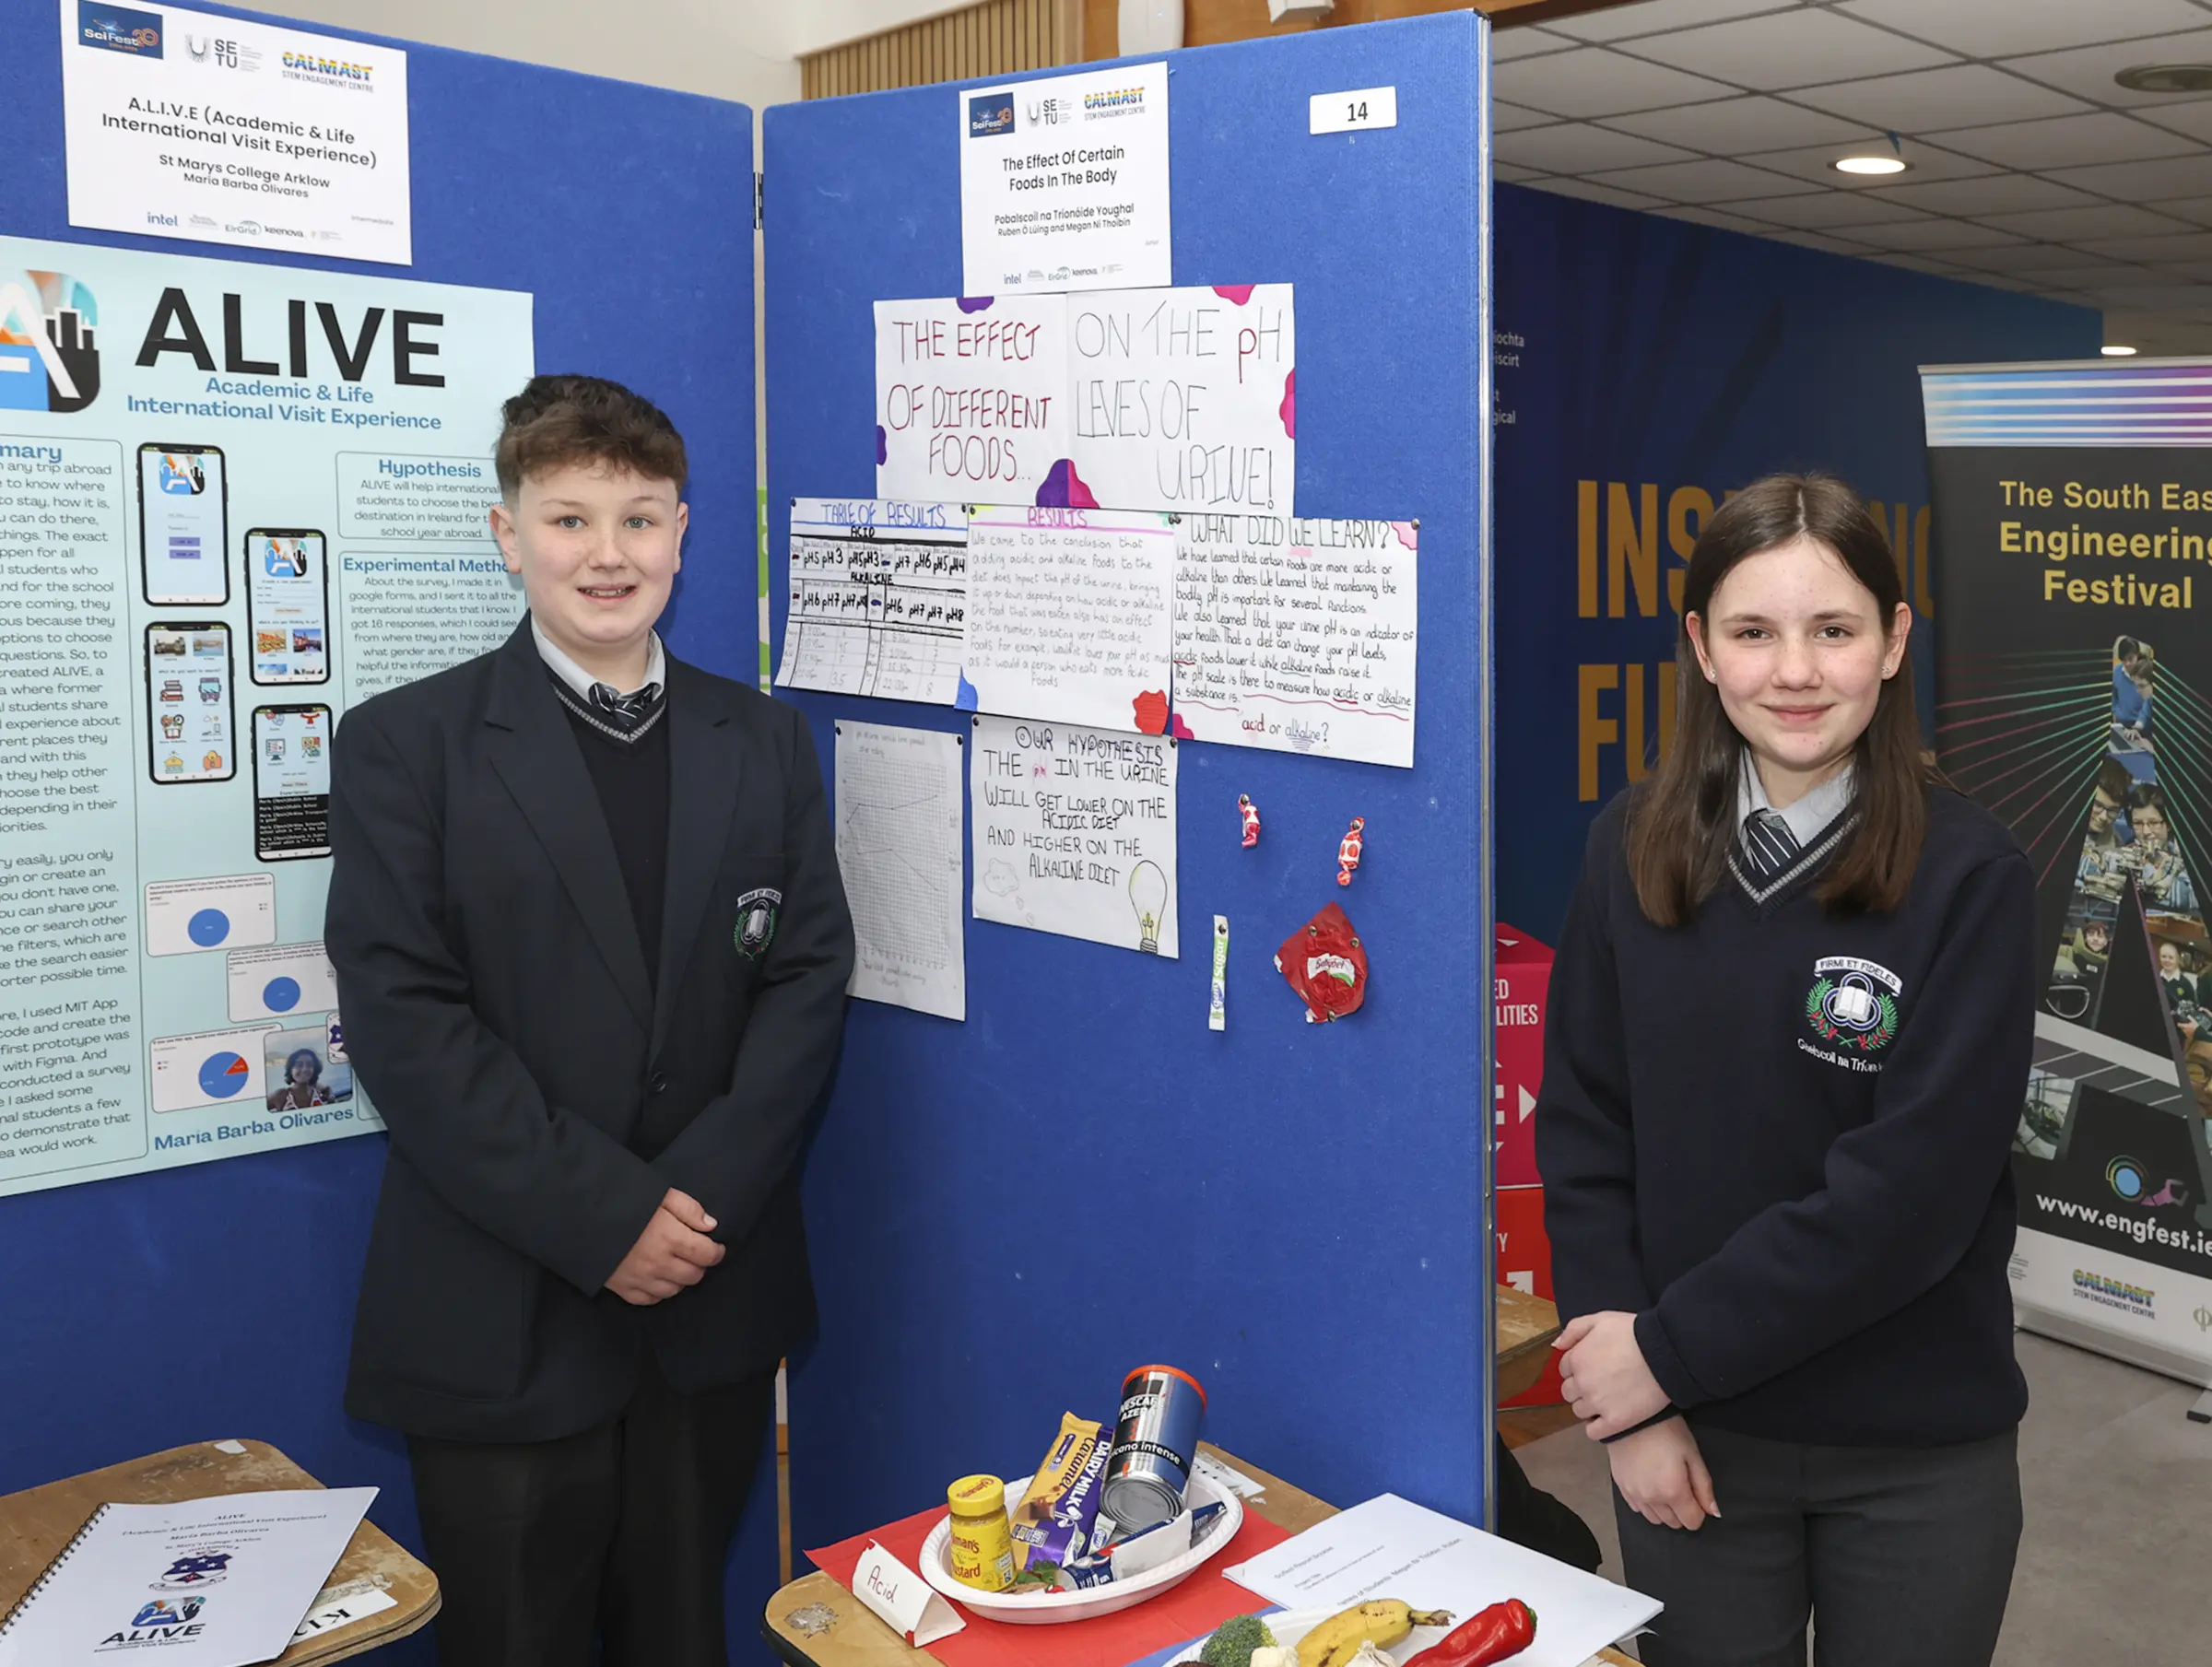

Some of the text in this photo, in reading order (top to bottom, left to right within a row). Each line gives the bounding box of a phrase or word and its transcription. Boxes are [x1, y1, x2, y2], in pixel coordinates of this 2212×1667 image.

[215, 39, 237, 54] SE
[215, 53, 238, 68] TU
[282, 52, 372, 81] CALMAST
[282, 70, 373, 92] STEM ENGAGEMENT CENTRE
[1043, 99, 1057, 112] SE
[1084, 87, 1145, 110] CALMAST
[1347, 101, 1368, 123] 14
[128, 97, 355, 144] A.L.I.V.E (Academic & Life
[1044, 112, 1057, 125] TU
[102, 113, 377, 169] International Visit Experience)
[159, 154, 330, 188] St Marys College Arklow
[1003, 146, 1124, 171] The Effect Of Certain
[184, 173, 309, 198] Maria Barba Olivares
[1009, 168, 1118, 191] Foods In The Body
[147, 212, 178, 227] intel
[265, 226, 304, 239] keenova
[994, 203, 1135, 225] Pobalscoil na Tríonóide Youghal
[998, 228, 1020, 236] Ruben
[1066, 222, 1092, 232] Megan
[1004, 275, 1021, 285] intel
[135, 287, 446, 388] ALIVE
[892, 320, 1041, 364] THE EFFECT
[1076, 300, 1281, 383] ON THE pH
[206, 377, 373, 404] Academic & Life
[127, 395, 441, 429] International Visit Experience
[888, 385, 1051, 430] OF DIFFERENT
[1077, 380, 1206, 440] LEVES OF
[7, 463, 112, 475] any trip abroad
[379, 460, 481, 478] Hypothesis
[1157, 444, 1274, 509] URINE!
[360, 479, 433, 493] ALIVE will help
[1999, 481, 2053, 507] The
[2064, 481, 2149, 509] South
[821, 502, 946, 529] TABLE OF RESULTS
[1028, 507, 1088, 528] RESULTS
[851, 527, 875, 537] ACID
[1191, 514, 1390, 549] WHAT DID WE LEARN?
[344, 558, 455, 573] Experimental
[851, 573, 893, 585] ALKALINE
[2044, 569, 2193, 608] Festival
[1242, 713, 1265, 732] acid
[1269, 724, 1281, 734] or
[1016, 726, 1163, 766] OUR HYPOTHESIS
[983, 750, 1169, 786] THE IN THE URINE
[984, 781, 1167, 818] WILL GET LOWER ON THE
[1042, 809, 1120, 829] ACIDIC DIET
[988, 826, 1142, 857] AND HIGHER ON THE
[1030, 853, 1120, 886] ALKALINE DIET
[1820, 959, 1896, 986] FIRMI ET FIDELES
[1838, 1056, 1849, 1067] na
[155, 1109, 354, 1151] Maria Barba Olivares
[19, 1135, 98, 1156] would work.
[2073, 1269, 2155, 1307] CALMAST
[2091, 1295, 2131, 1311] ENGAGEMENT
[2132, 1306, 2155, 1320] CENTRE
[1061, 1438, 1096, 1489] Caramel
[1141, 1442, 1180, 1464] intense
[1065, 1440, 1111, 1508] DAIRY MILK
[867, 1566, 898, 1603] Acid
[100, 1623, 206, 1645] ALIVE
